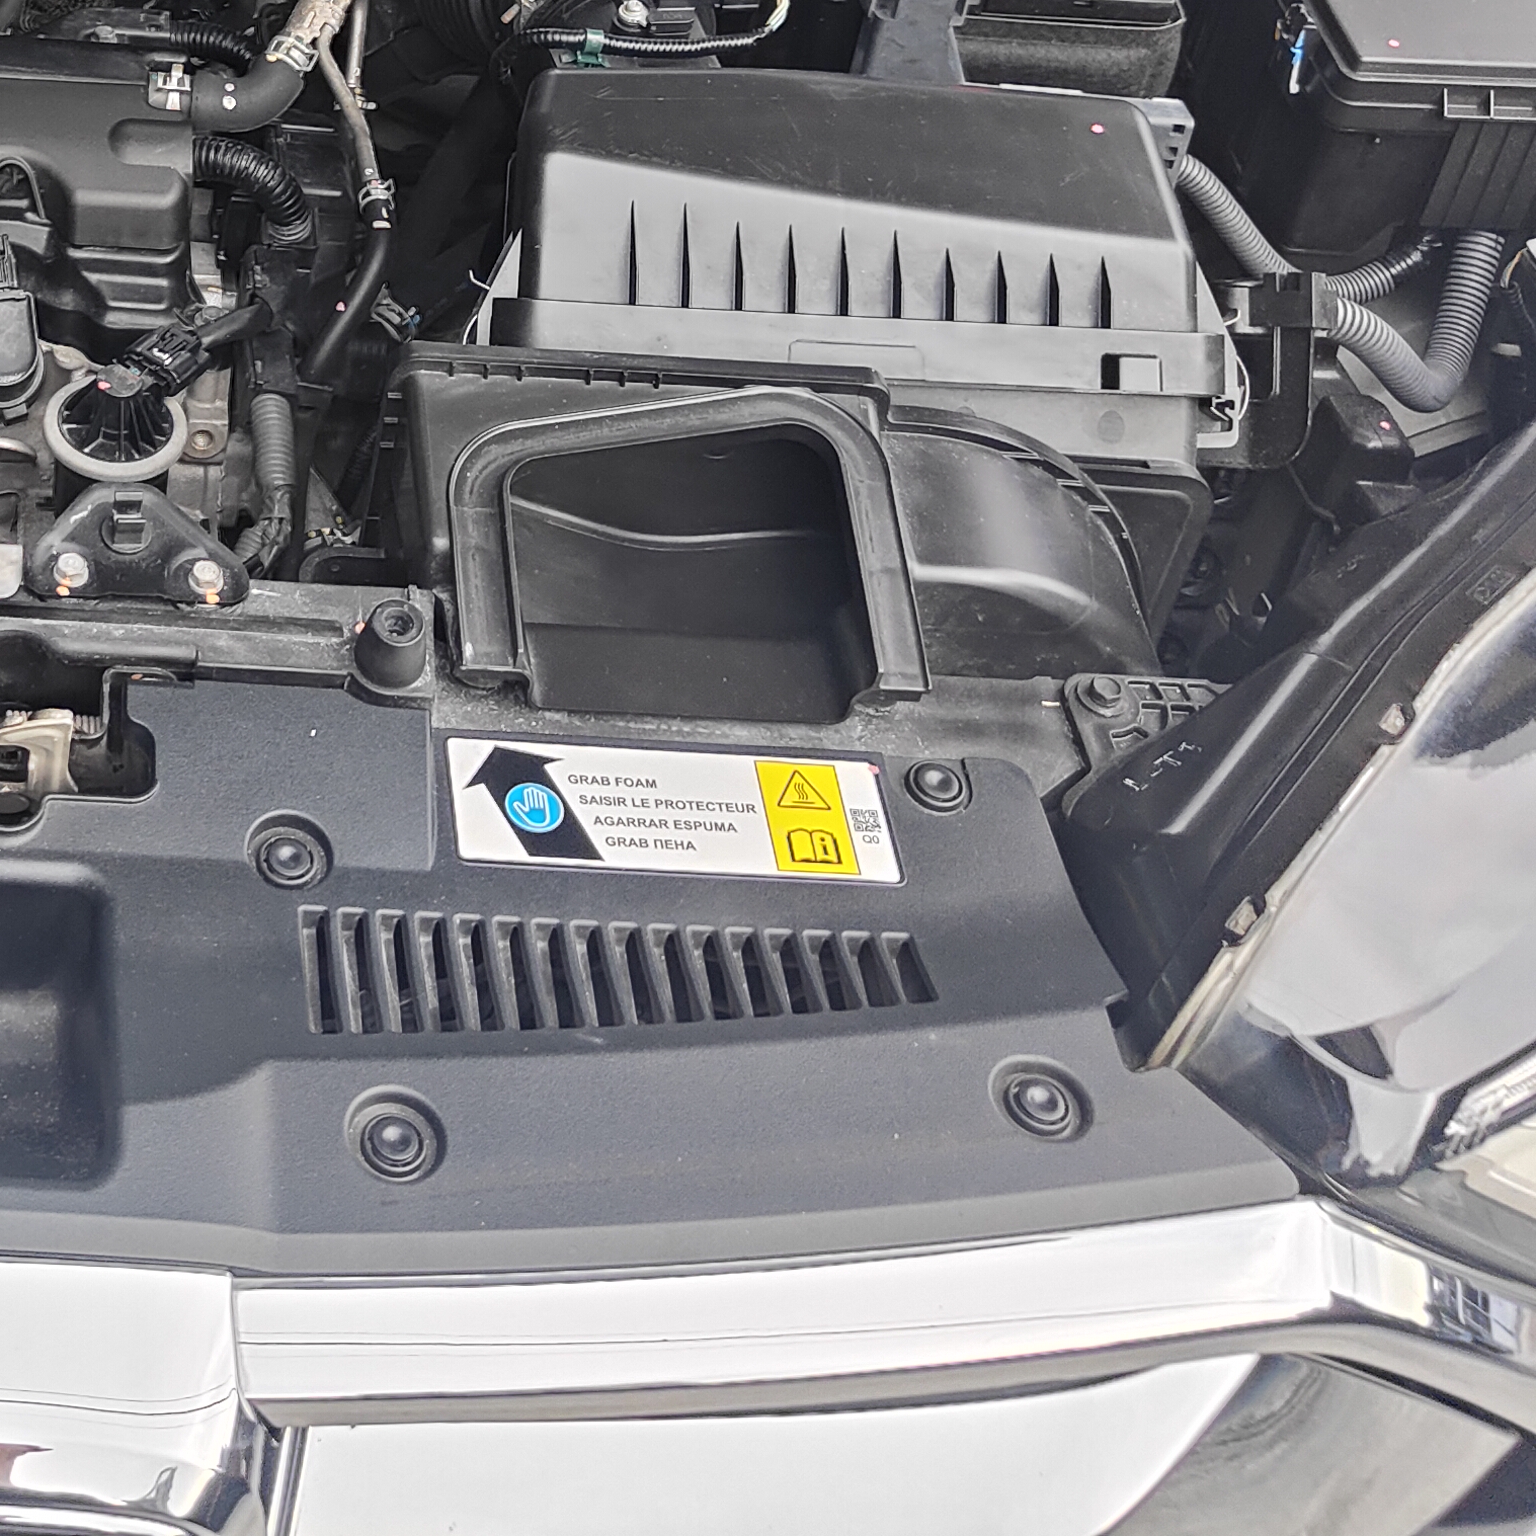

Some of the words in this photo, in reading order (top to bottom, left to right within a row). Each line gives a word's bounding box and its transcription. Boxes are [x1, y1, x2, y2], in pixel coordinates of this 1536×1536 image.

[567, 774, 611, 787] GRAB
[614, 776, 658, 789] FOAM
[578, 794, 628, 807] SAISIR
[631, 797, 651, 809] LE
[654, 798, 757, 814] PROTECTEUR
[593, 815, 670, 830] AGARRAR
[673, 819, 739, 833] ESPUMA
[605, 836, 649, 849] GRAB
